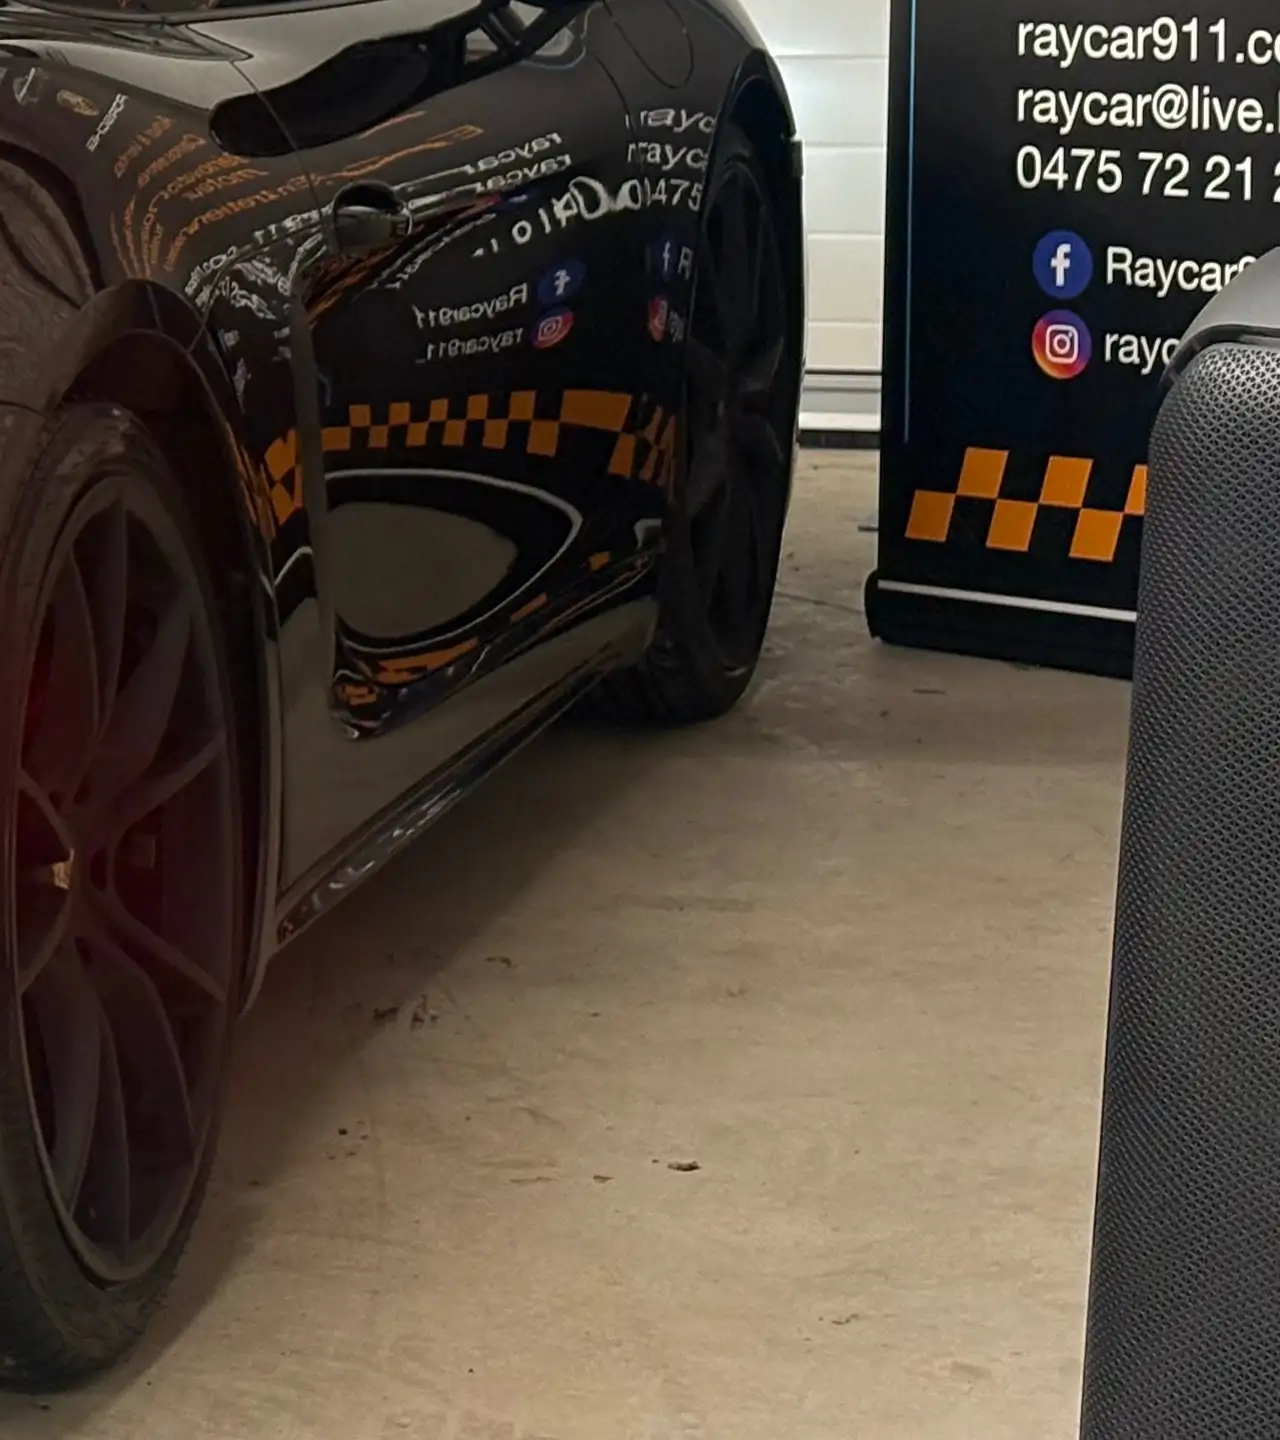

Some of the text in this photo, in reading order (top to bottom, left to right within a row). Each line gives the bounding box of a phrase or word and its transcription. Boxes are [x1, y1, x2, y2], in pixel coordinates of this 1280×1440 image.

[1017, 16, 1280, 68] raycar911.c
[1017, 84, 1280, 136] raycar@live.
[1016, 145, 1122, 194] 0475
[1138, 151, 1189, 197] 72
[1204, 154, 1252, 202] 21
[1106, 246, 1257, 298] Raycar
